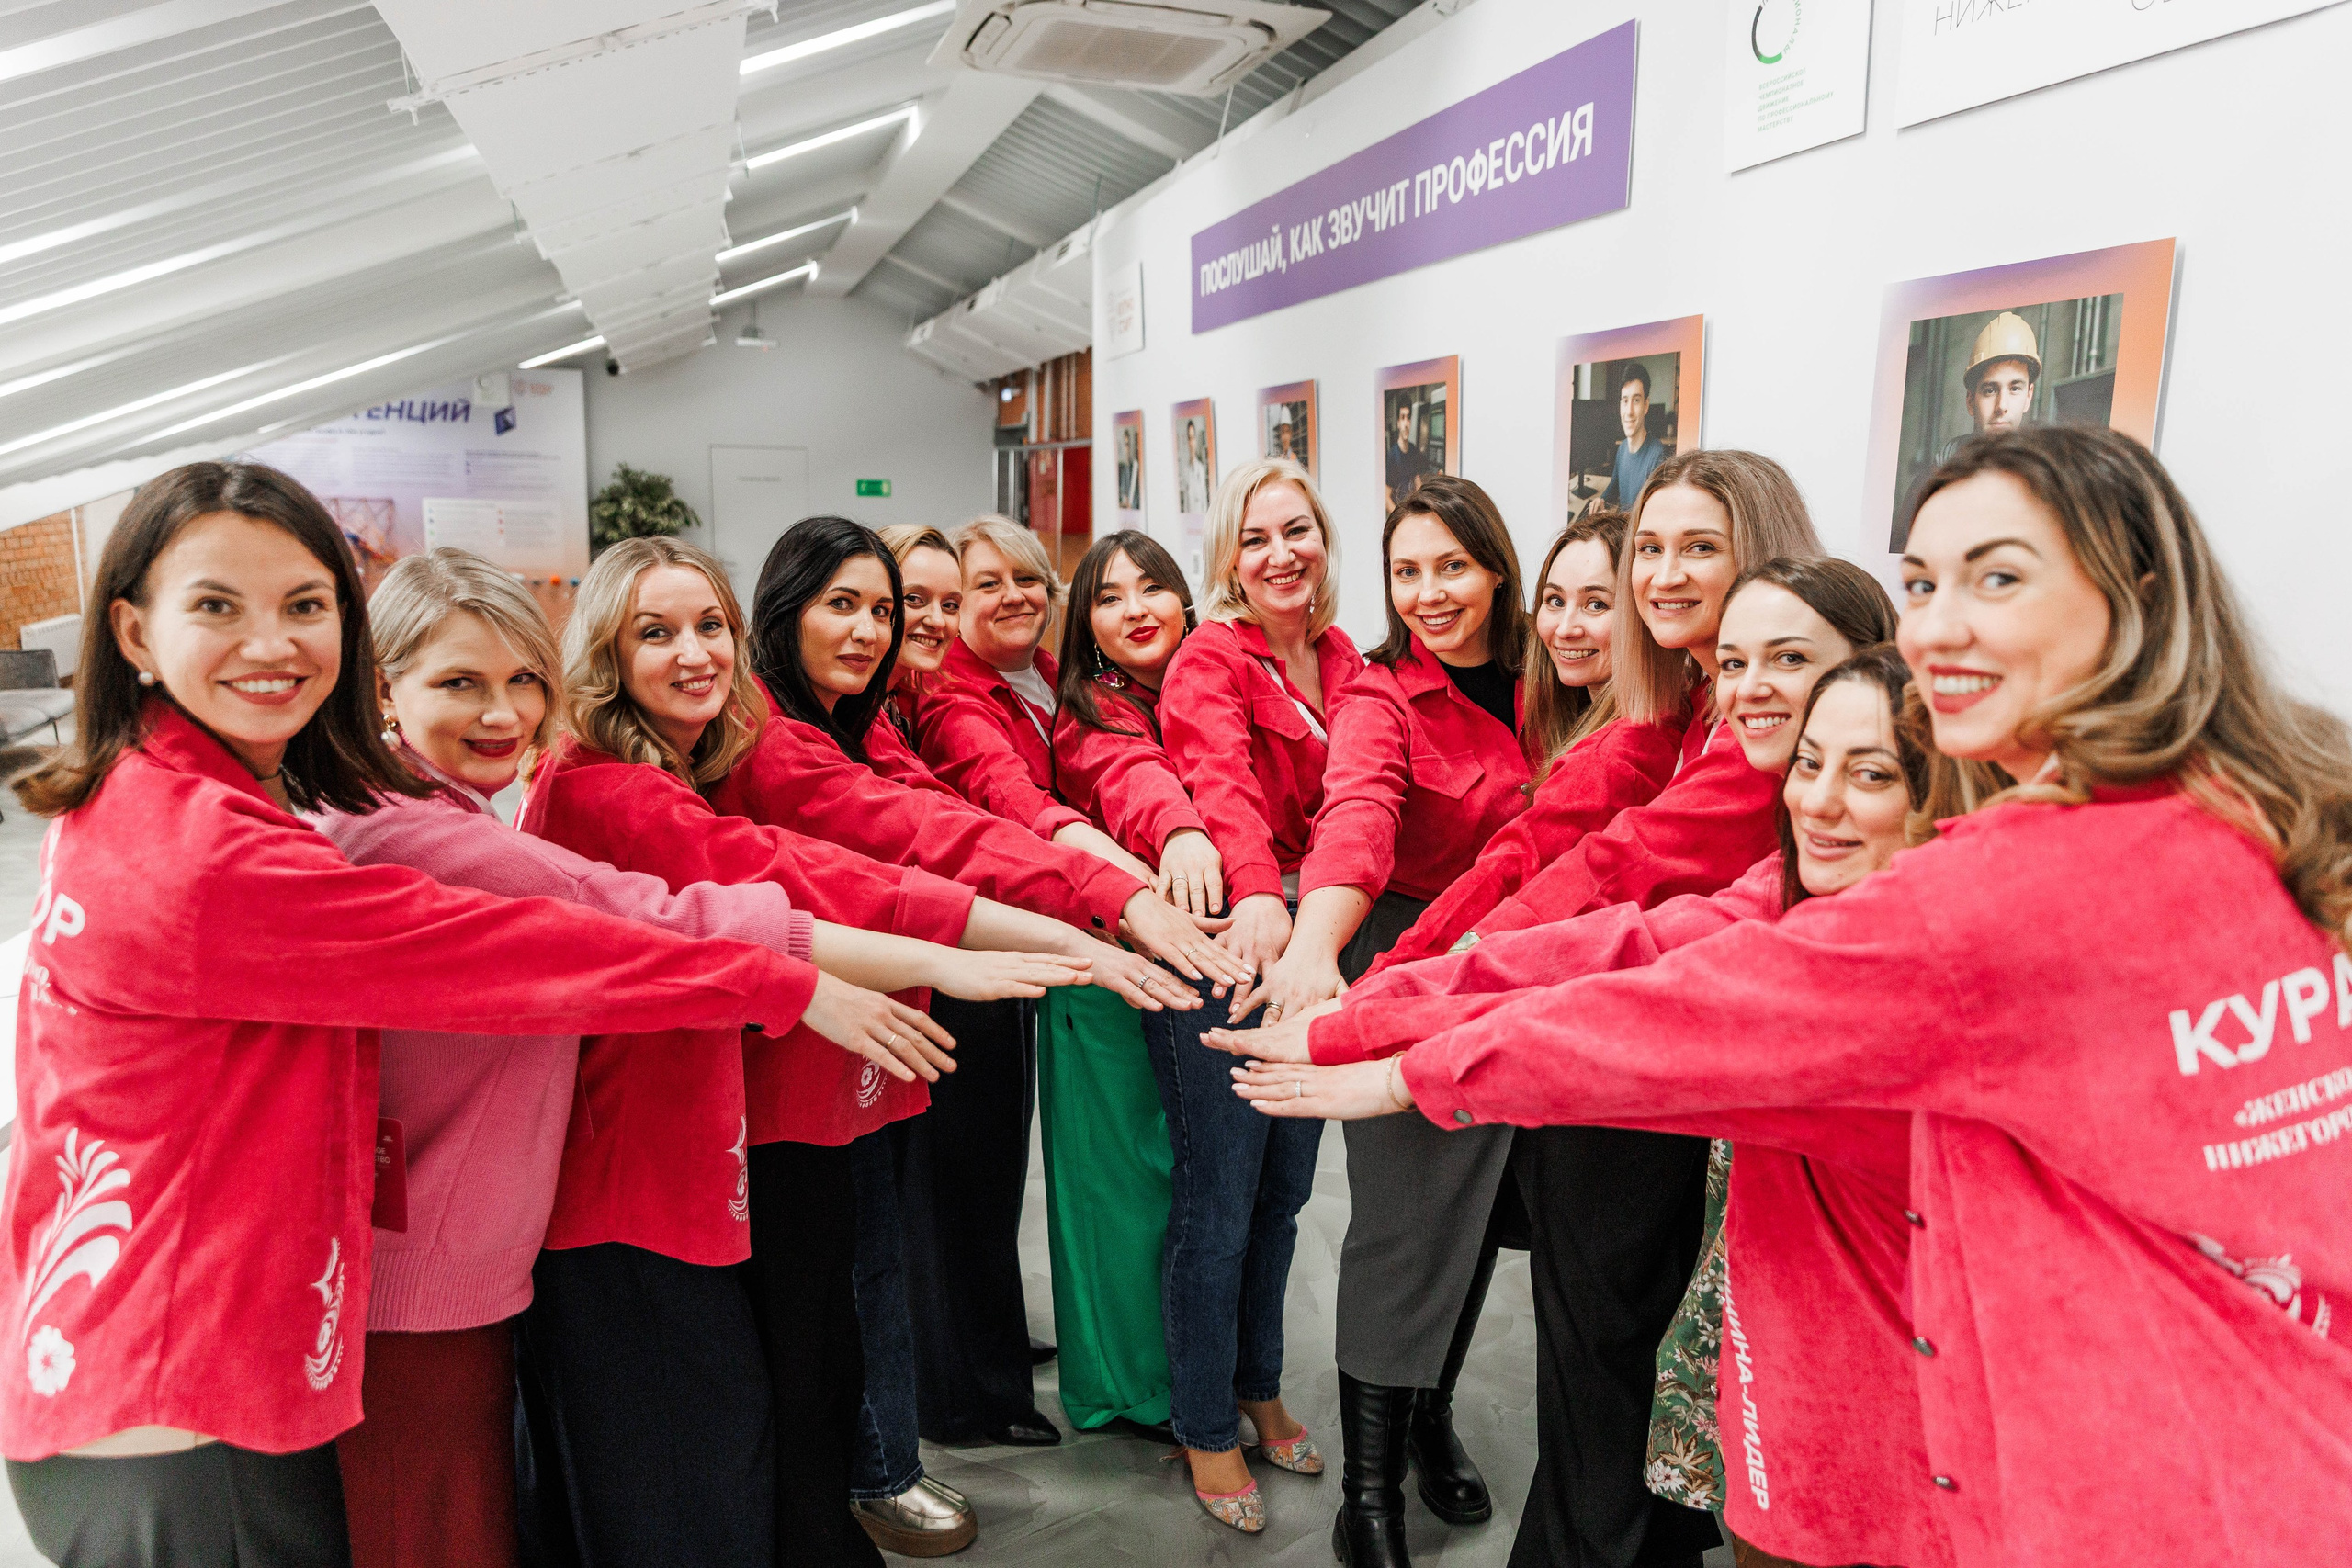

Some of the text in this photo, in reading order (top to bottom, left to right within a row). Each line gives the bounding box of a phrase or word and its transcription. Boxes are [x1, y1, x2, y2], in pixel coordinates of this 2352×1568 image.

[1758, 68, 1806, 90] ВСЕРОССИЙСКОЕ
[1758, 80, 1804, 100] ЧЕМПИОНАТНОЕ
[1758, 96, 1790, 112] ДВИЖЕНИЕ
[1767, 91, 1834, 118] ПРОФЕССИОНАЛЬНОМУ
[1758, 116, 1793, 132] МАСТЕРСТВУ
[1200, 101, 1595, 298] ПОСЛУШАЙ, КАК ЗВУЧИТ ПРОФЕССИЯ
[353, 397, 471, 424] ЕНЦИЙ
